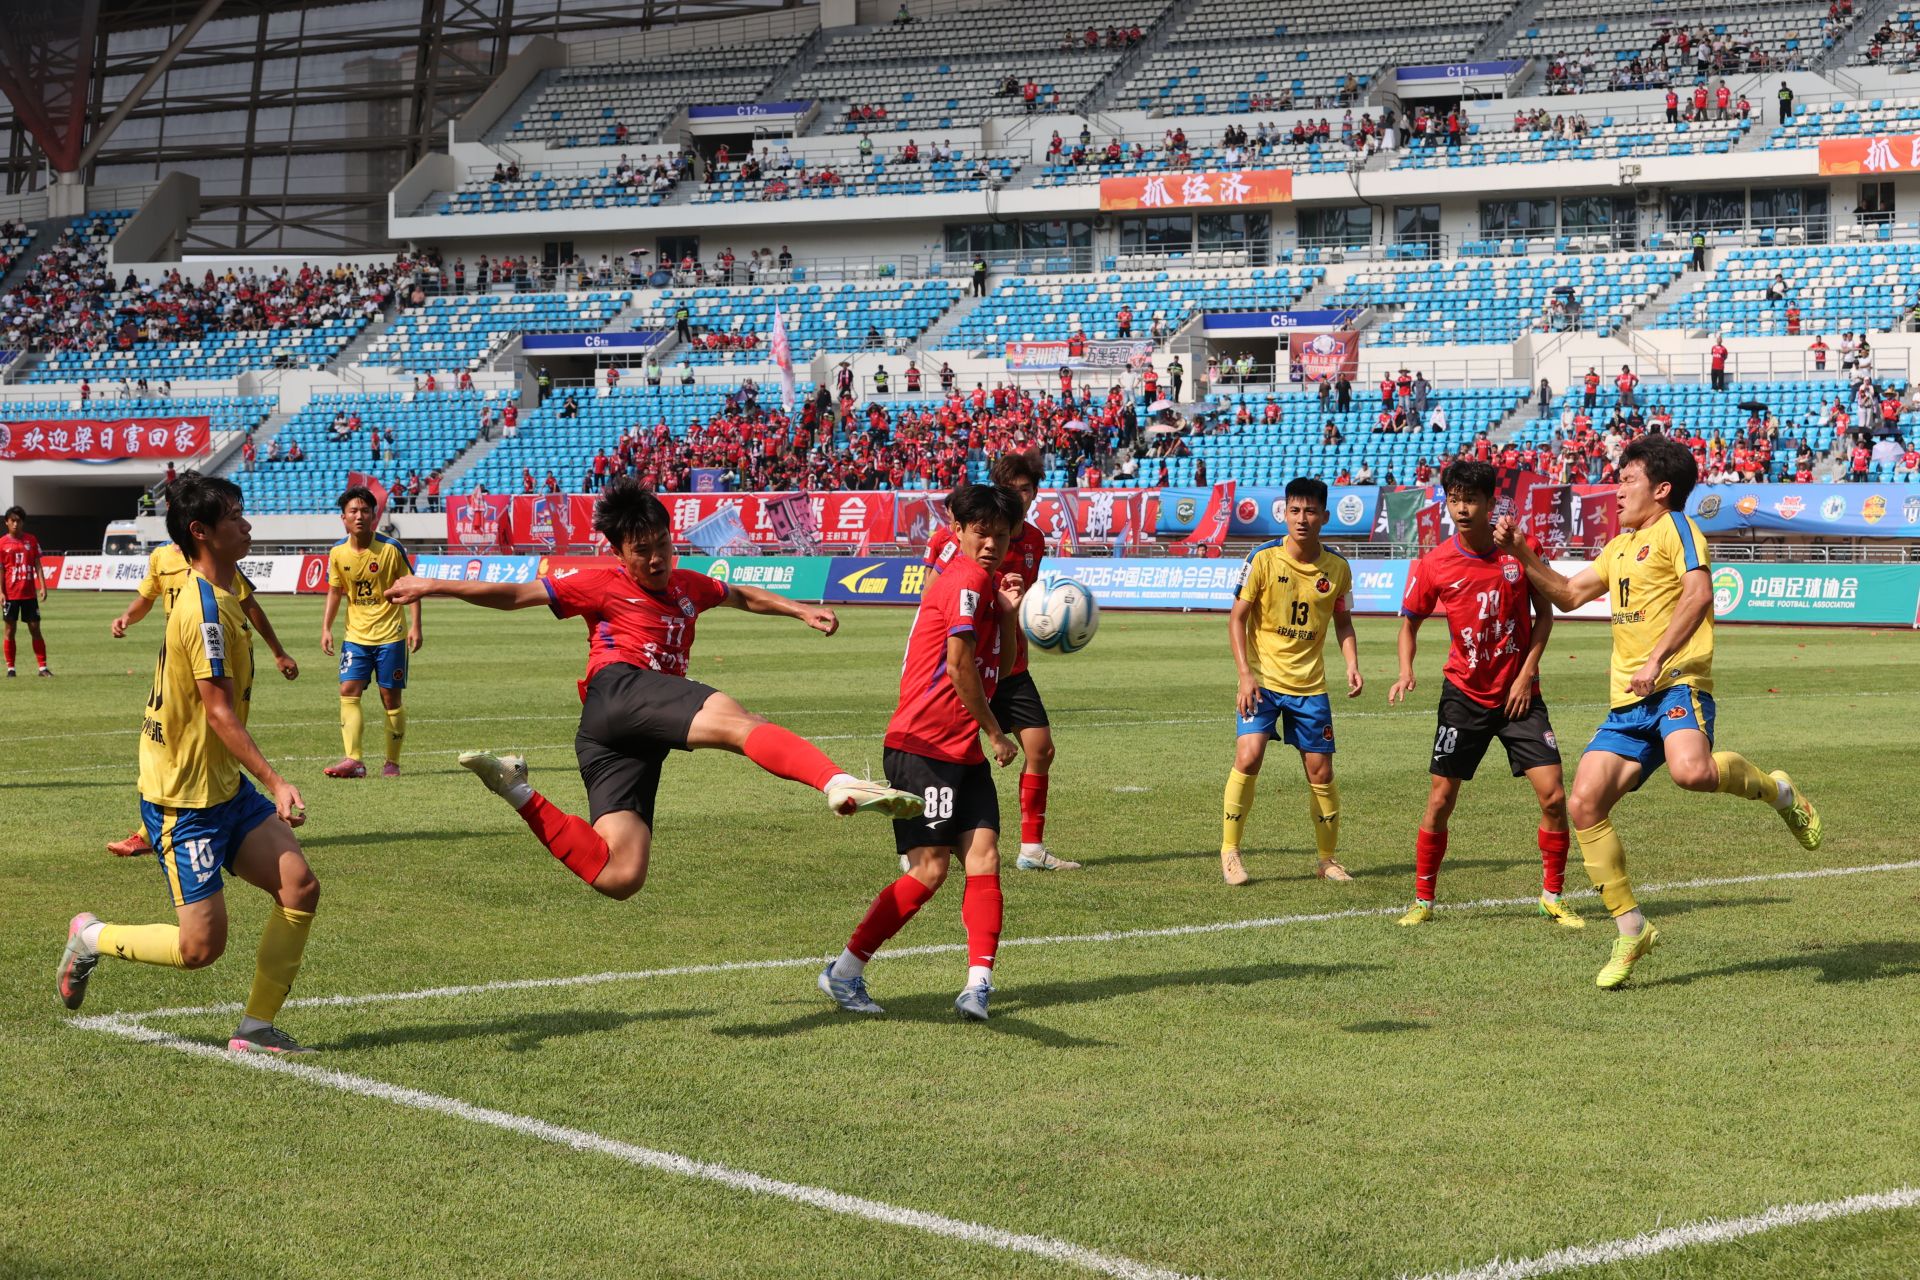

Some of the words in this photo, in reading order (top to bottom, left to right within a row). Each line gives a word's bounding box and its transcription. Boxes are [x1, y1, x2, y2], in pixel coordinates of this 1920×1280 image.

[1446, 66, 1470, 77] C11
[736, 105, 759, 116] C12
[1863, 136, 1920, 171] 抓
[1140, 174, 1252, 207] 抓经济
[1271, 315, 1288, 327] C5
[585, 336, 601, 347] C6
[22, 421, 195, 453] 欢迎梁日富回家
[732, 566, 794, 582] 中国足球协会
[1359, 572, 1394, 589] CMCL
[355, 580, 373, 597] 23
[1749, 576, 1859, 599] 中国足球协会
[1290, 600, 1310, 626] 13
[1476, 590, 1500, 620] 28
[1747, 600, 1775, 608] CHINESE
[1777, 600, 1811, 609] FOOTBALL
[1812, 601, 1856, 609] ASSOCIATION
[661, 615, 685, 648] 77
[1435, 725, 1458, 754] 28
[923, 786, 954, 819] 88
[184, 838, 215, 873] 10
